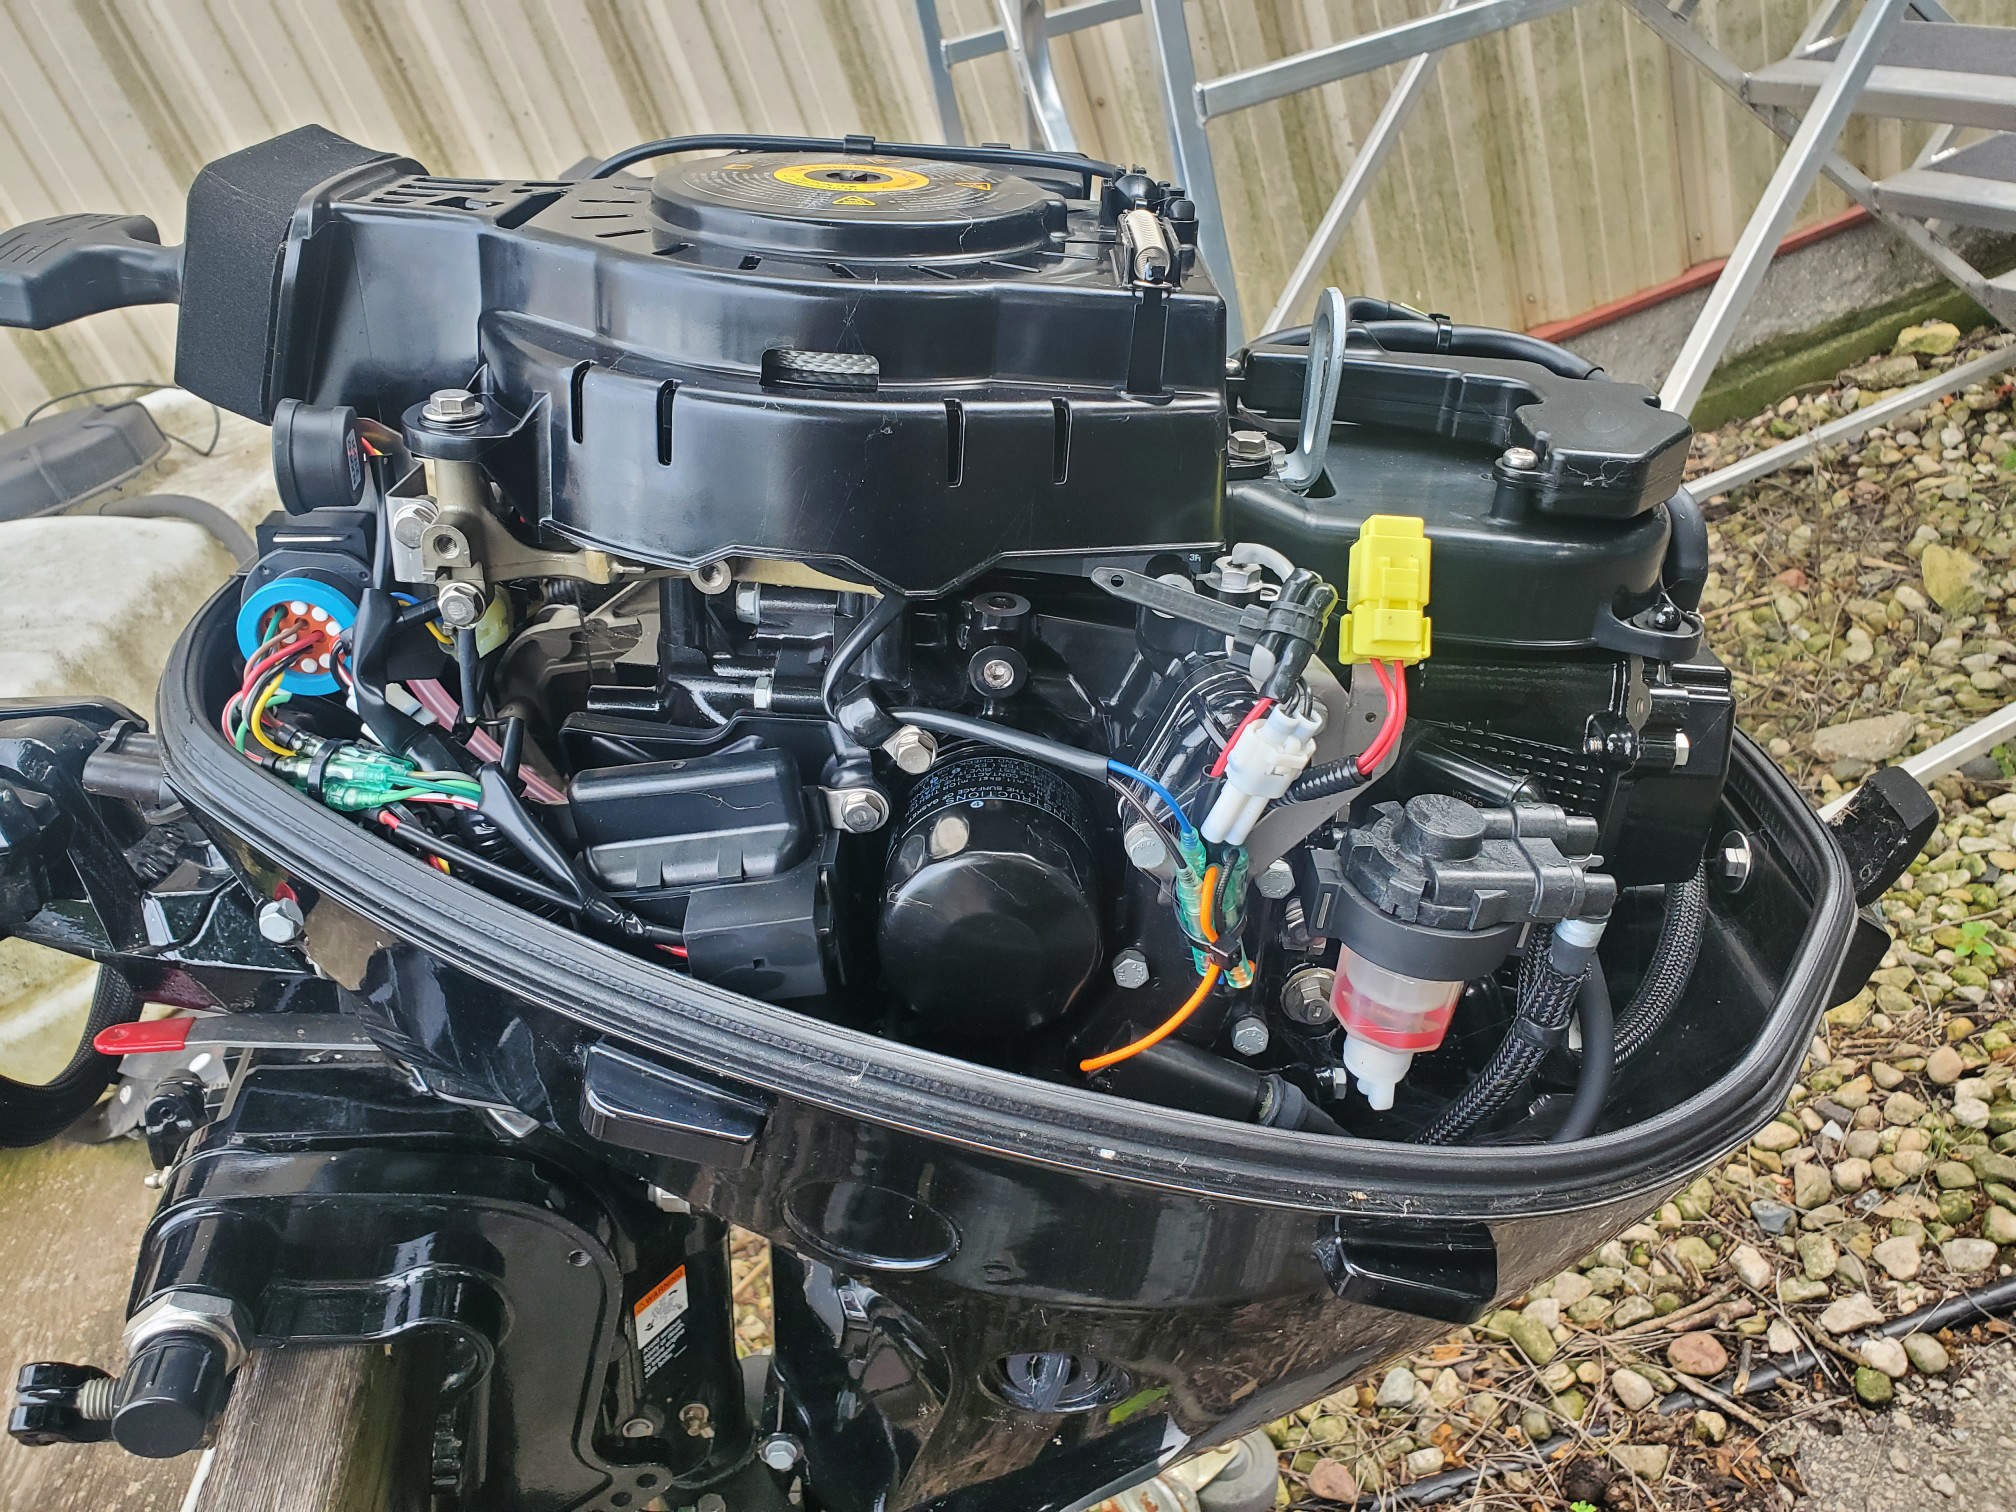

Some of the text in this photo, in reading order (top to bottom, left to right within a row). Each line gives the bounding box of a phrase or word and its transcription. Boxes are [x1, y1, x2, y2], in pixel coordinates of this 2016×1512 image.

[941, 790, 954, 801] OF
[957, 785, 1002, 795] SURFACE
[1005, 785, 1024, 794] THE
[908, 798, 939, 824] GASKET
[945, 791, 1066, 820] INSTRUCTIONS
[645, 1269, 683, 1304] WARNING
